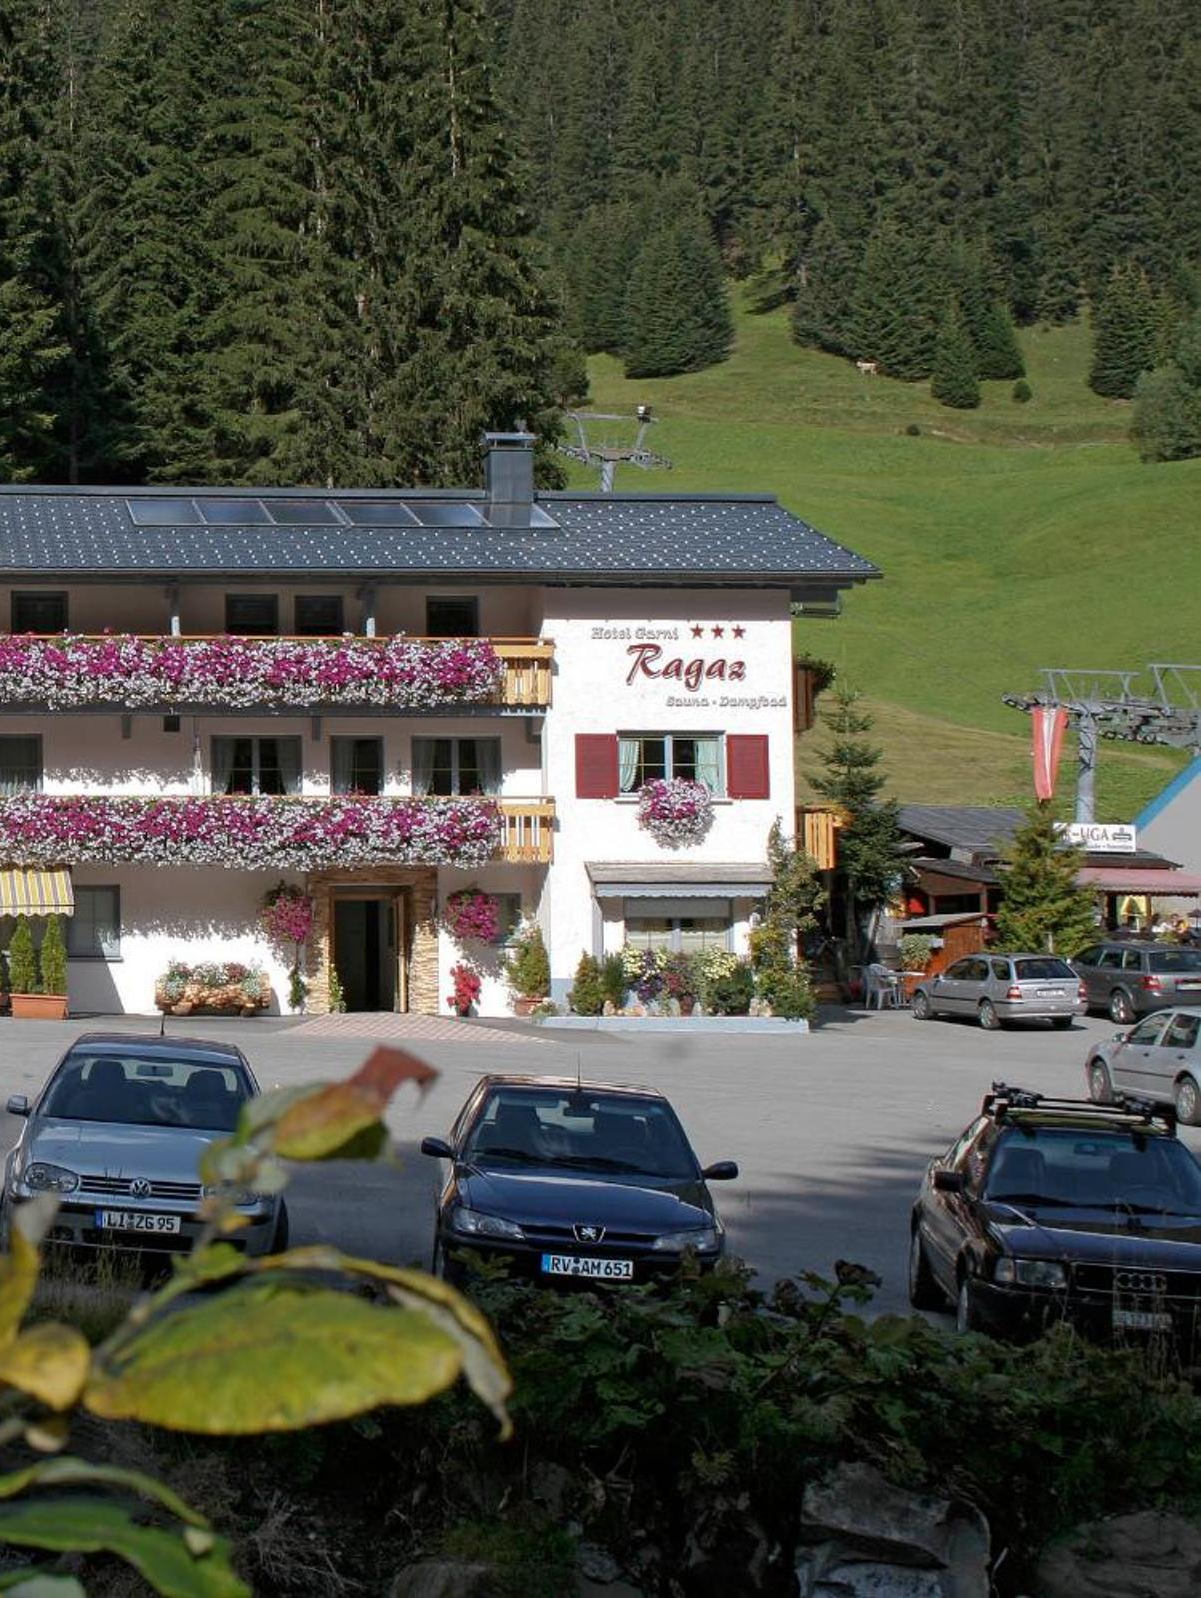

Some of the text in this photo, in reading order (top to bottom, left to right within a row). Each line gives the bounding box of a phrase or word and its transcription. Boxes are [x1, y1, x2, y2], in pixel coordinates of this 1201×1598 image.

[591, 627, 632, 640] Hotel
[626, 643, 747, 692] Ragaz
[665, 696, 788, 710] Sauna Dampfbad
[604, 1261, 632, 1277] 651
